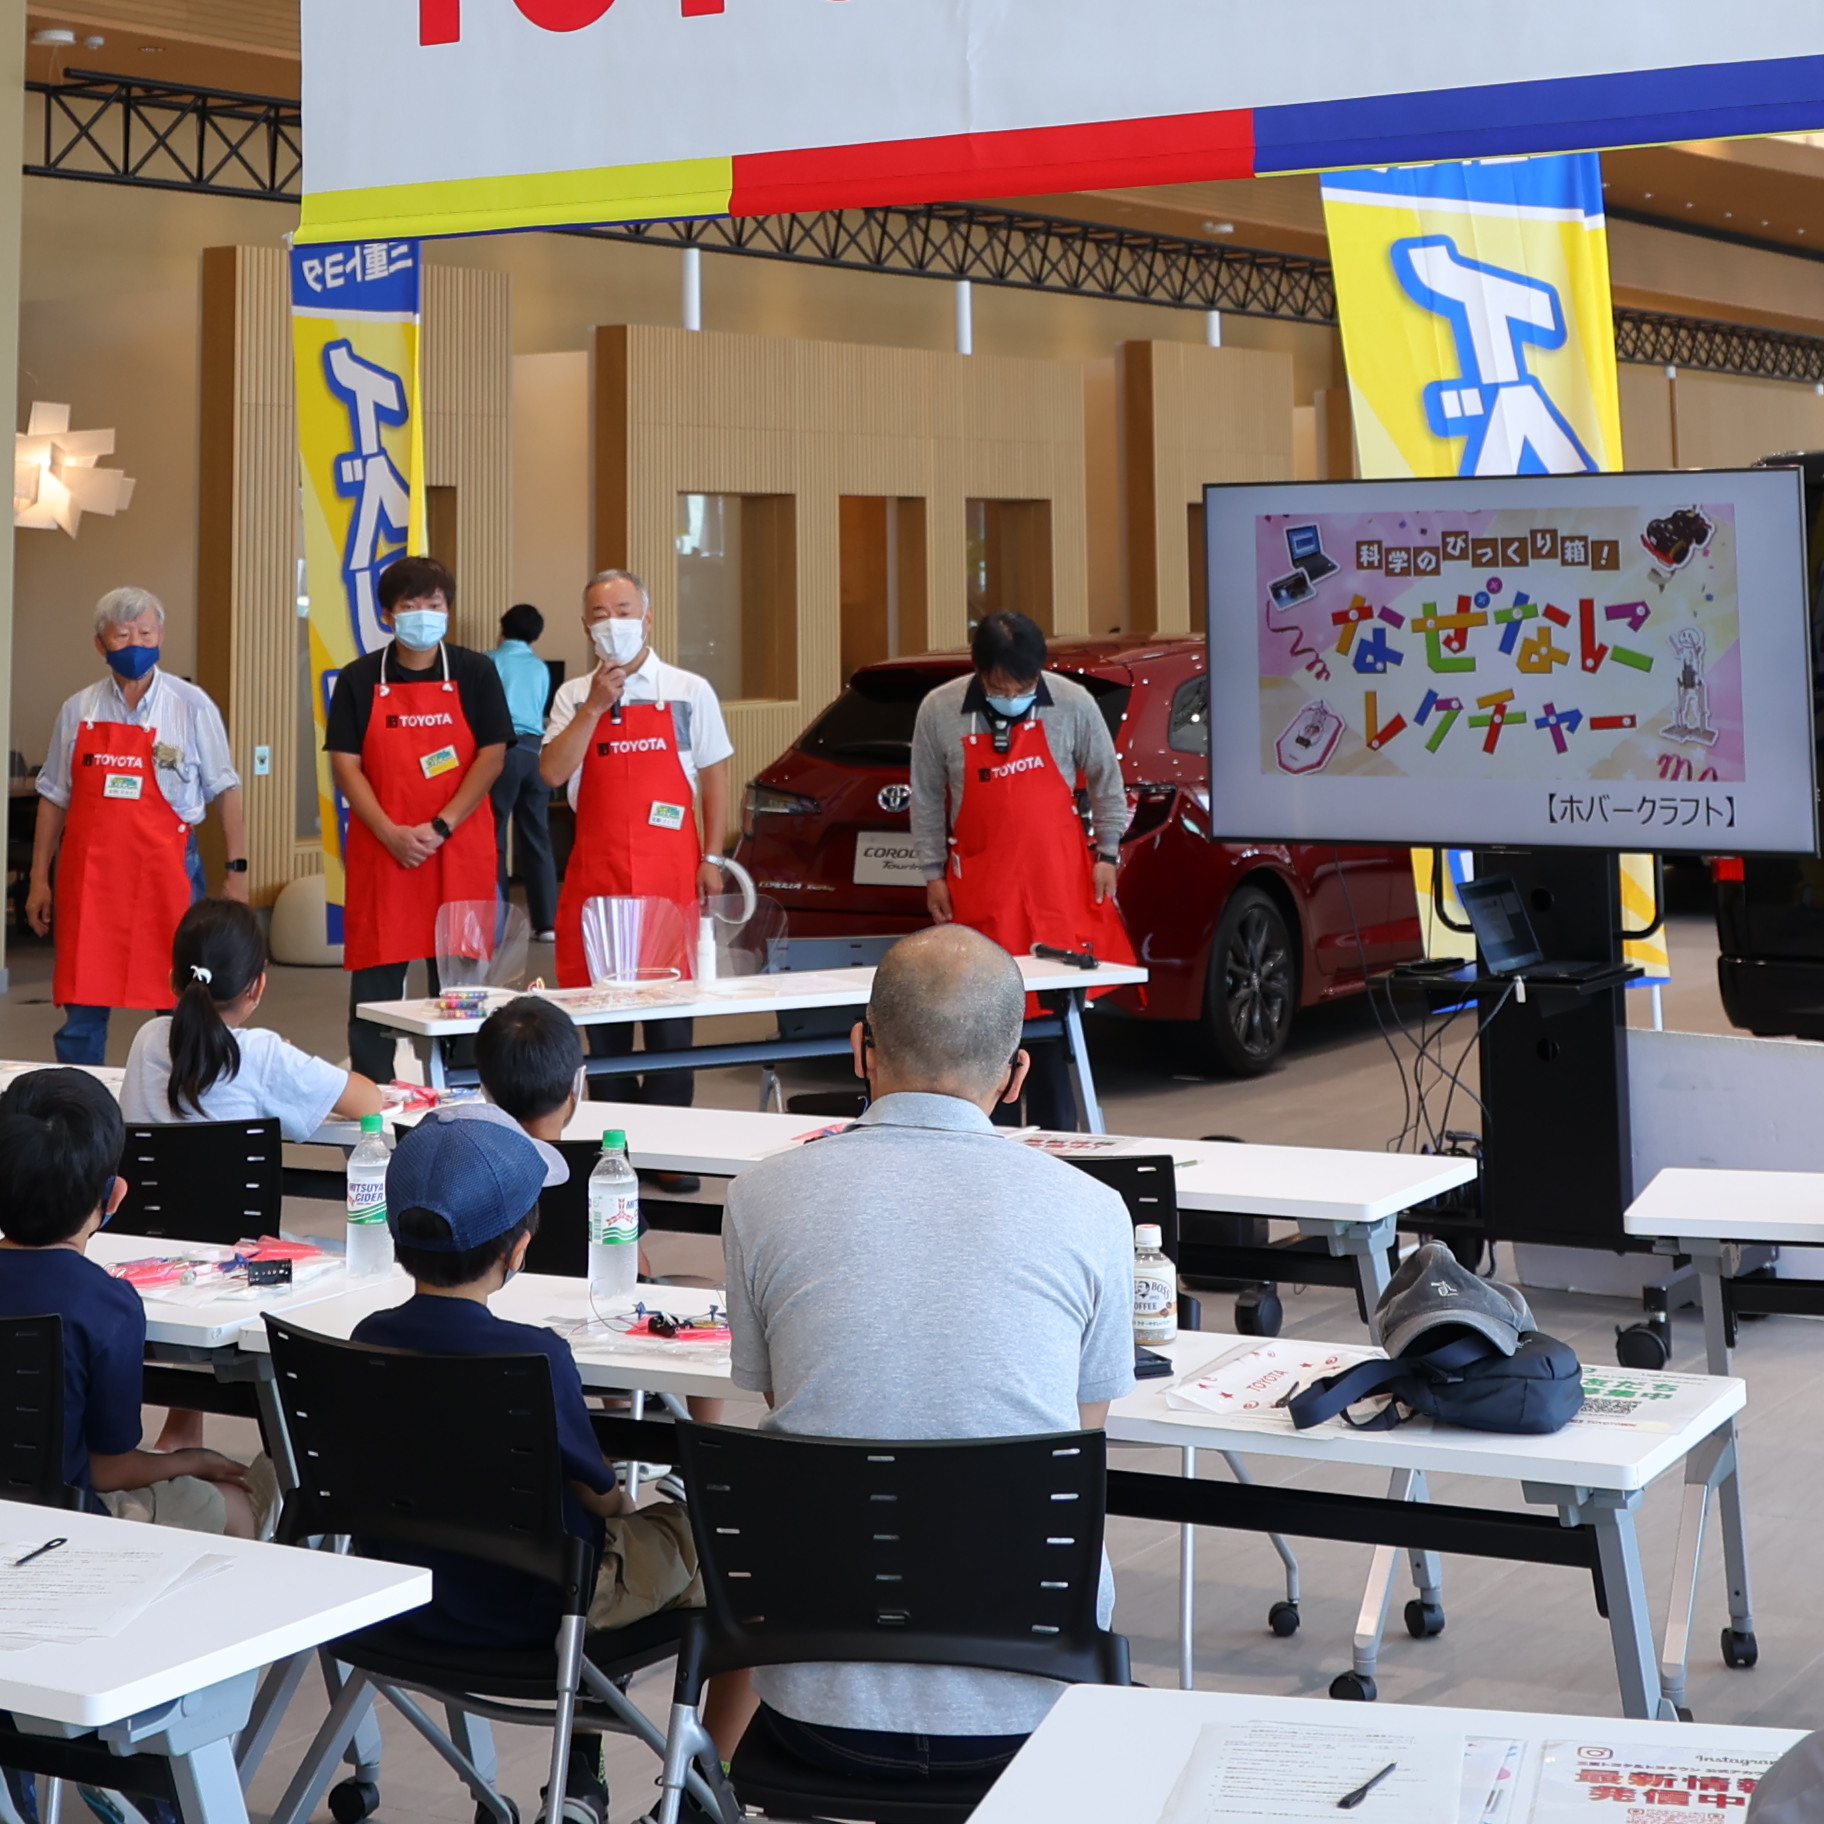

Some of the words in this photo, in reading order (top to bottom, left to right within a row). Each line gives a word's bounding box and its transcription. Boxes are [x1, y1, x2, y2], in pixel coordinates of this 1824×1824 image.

[1330, 590, 1655, 675] なぜなに
[399, 712, 453, 728] TOYOTA
[1364, 687, 1638, 755] レクチャー
[610, 737, 667, 754] TOYOTA
[94, 754, 143, 768] TOYOTA
[991, 755, 1044, 778] TOYOTA
[1548, 792, 1736, 829] 【ホバークラフト】
[863, 847, 920, 859] COROL
[882, 860, 924, 871] Tourin
[348, 1182, 384, 1193] MITSUYA
[355, 1192, 384, 1203] CIDER
[1151, 1281, 1170, 1300] BOSS
[1134, 1301, 1157, 1311] OFFEE
[1246, 1369, 1289, 1392] TOYOTA
[1588, 1785, 1747, 1809] 発信中
